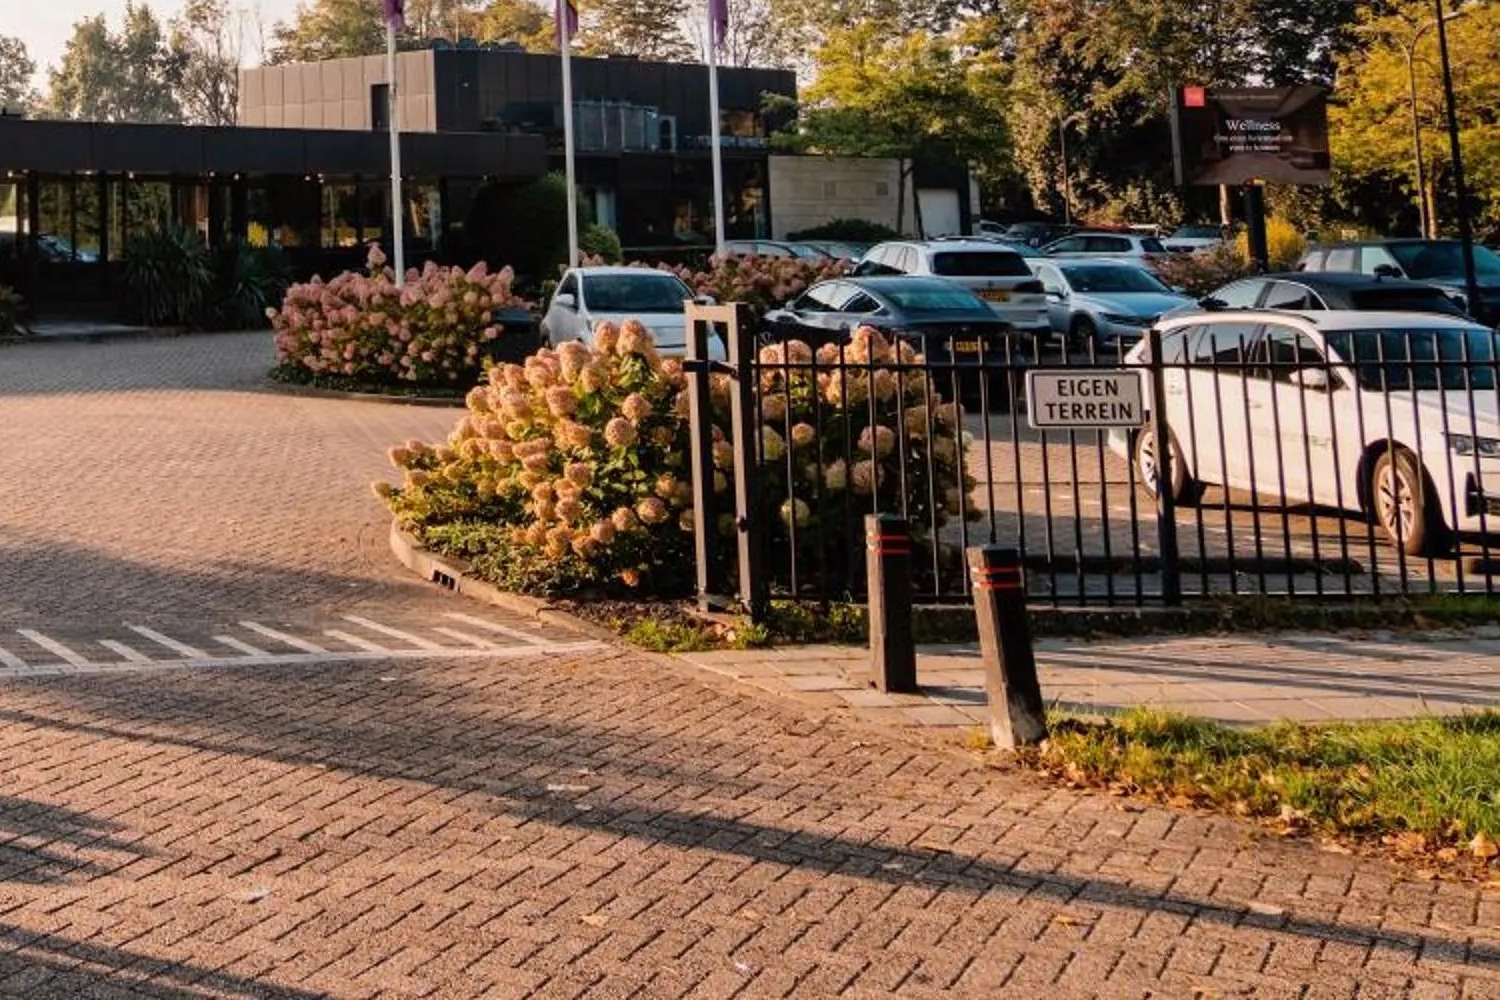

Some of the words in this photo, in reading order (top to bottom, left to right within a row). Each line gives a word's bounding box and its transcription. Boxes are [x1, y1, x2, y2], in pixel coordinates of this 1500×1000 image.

[1225, 119, 1281, 132] Wellness
[1057, 379, 1119, 397] EIGEN
[1045, 402, 1133, 421] TERREIN
